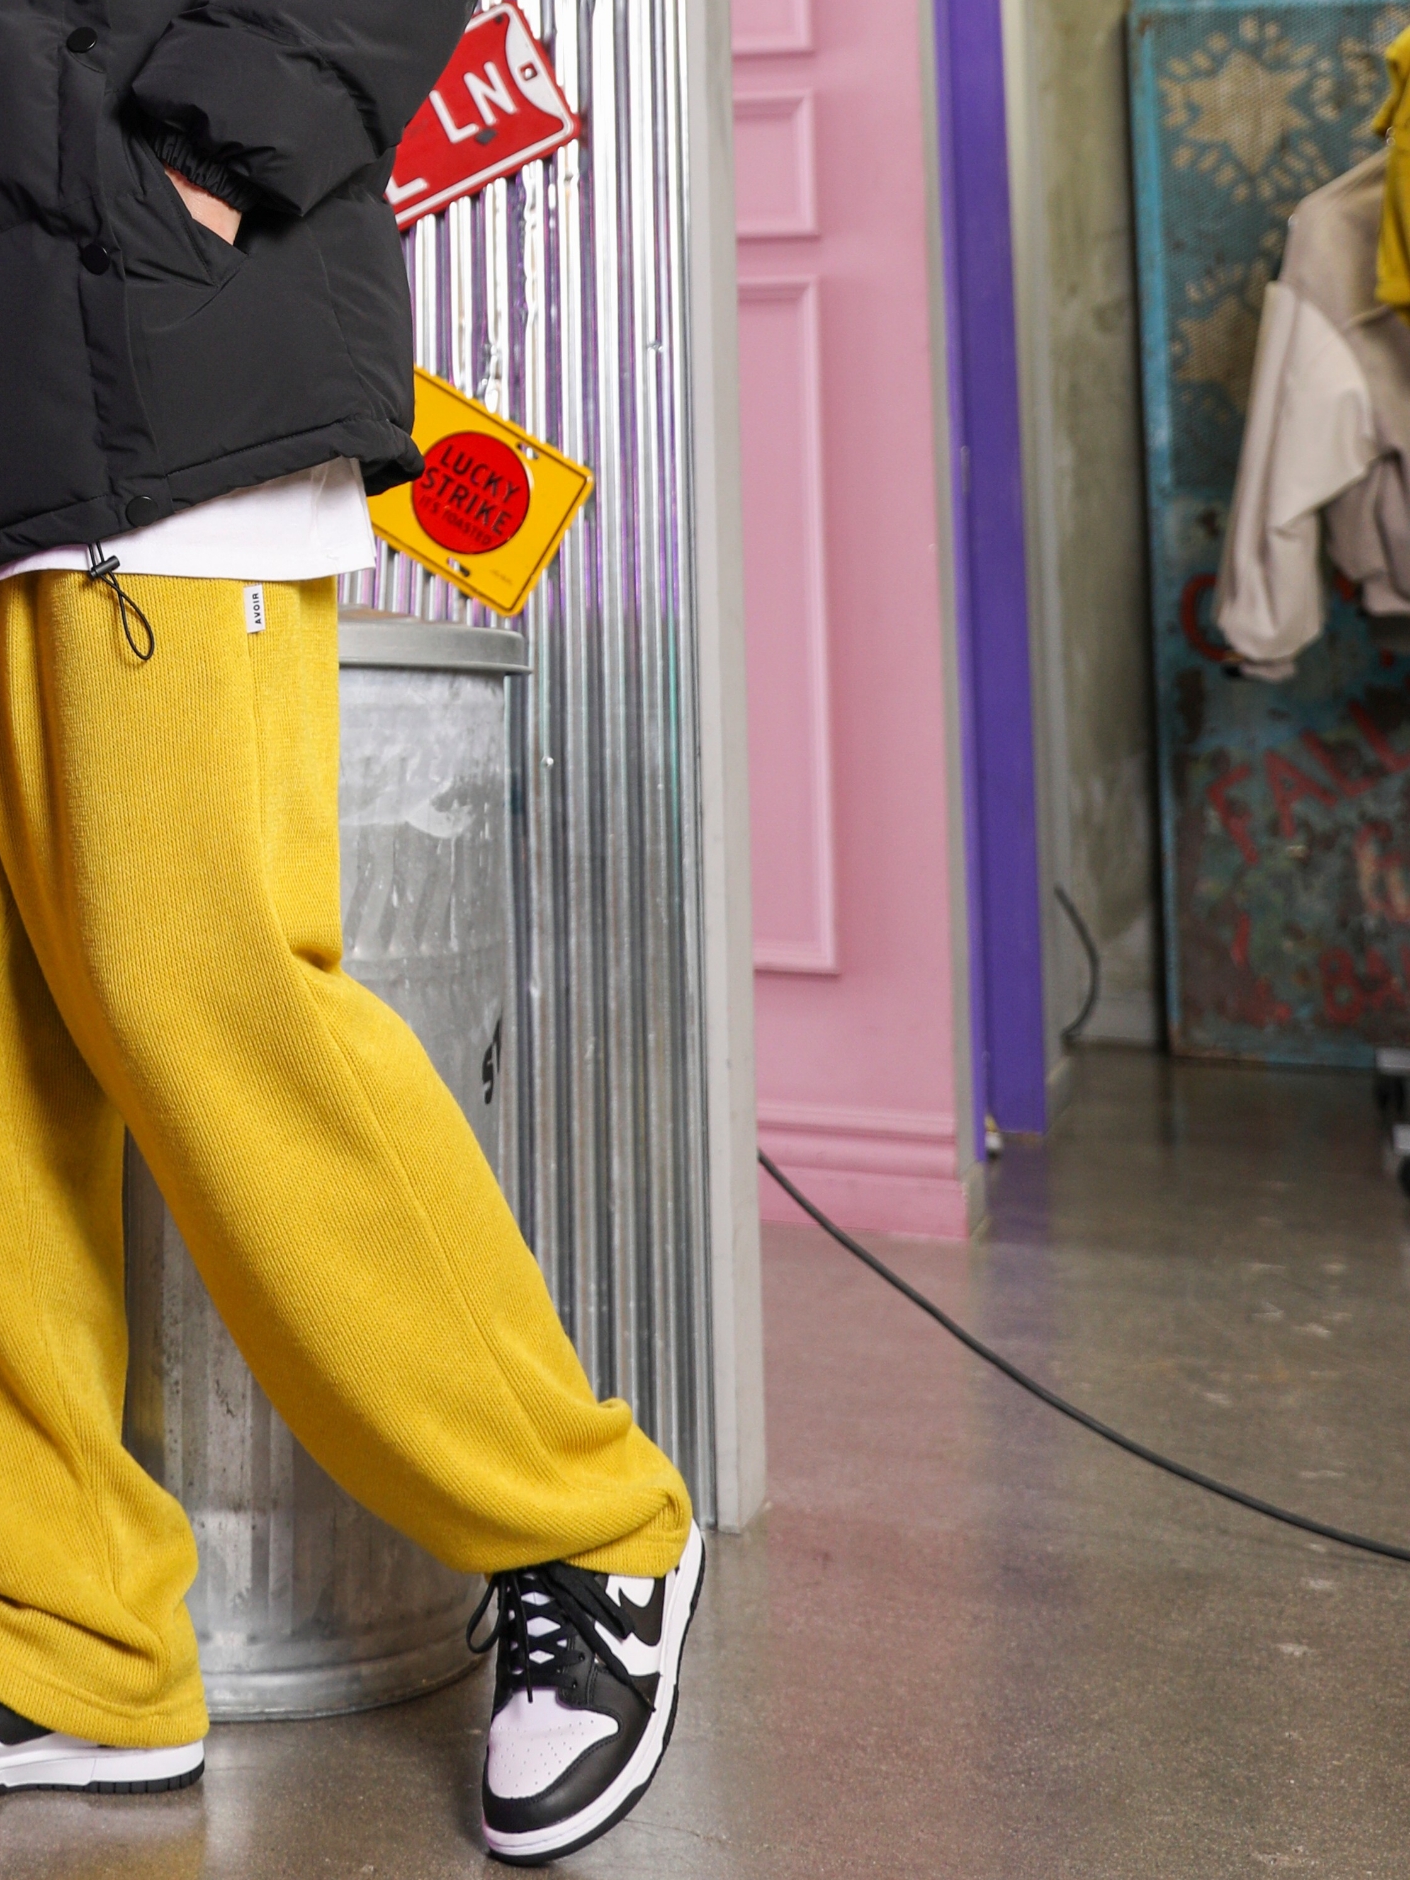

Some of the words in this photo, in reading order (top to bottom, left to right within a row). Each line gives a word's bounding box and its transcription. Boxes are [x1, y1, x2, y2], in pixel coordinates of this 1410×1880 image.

[429, 60, 518, 144] LN
[421, 466, 512, 536] STRIKE
[440, 443, 521, 504] LUCKY
[252, 592, 262, 625] AVOIR
